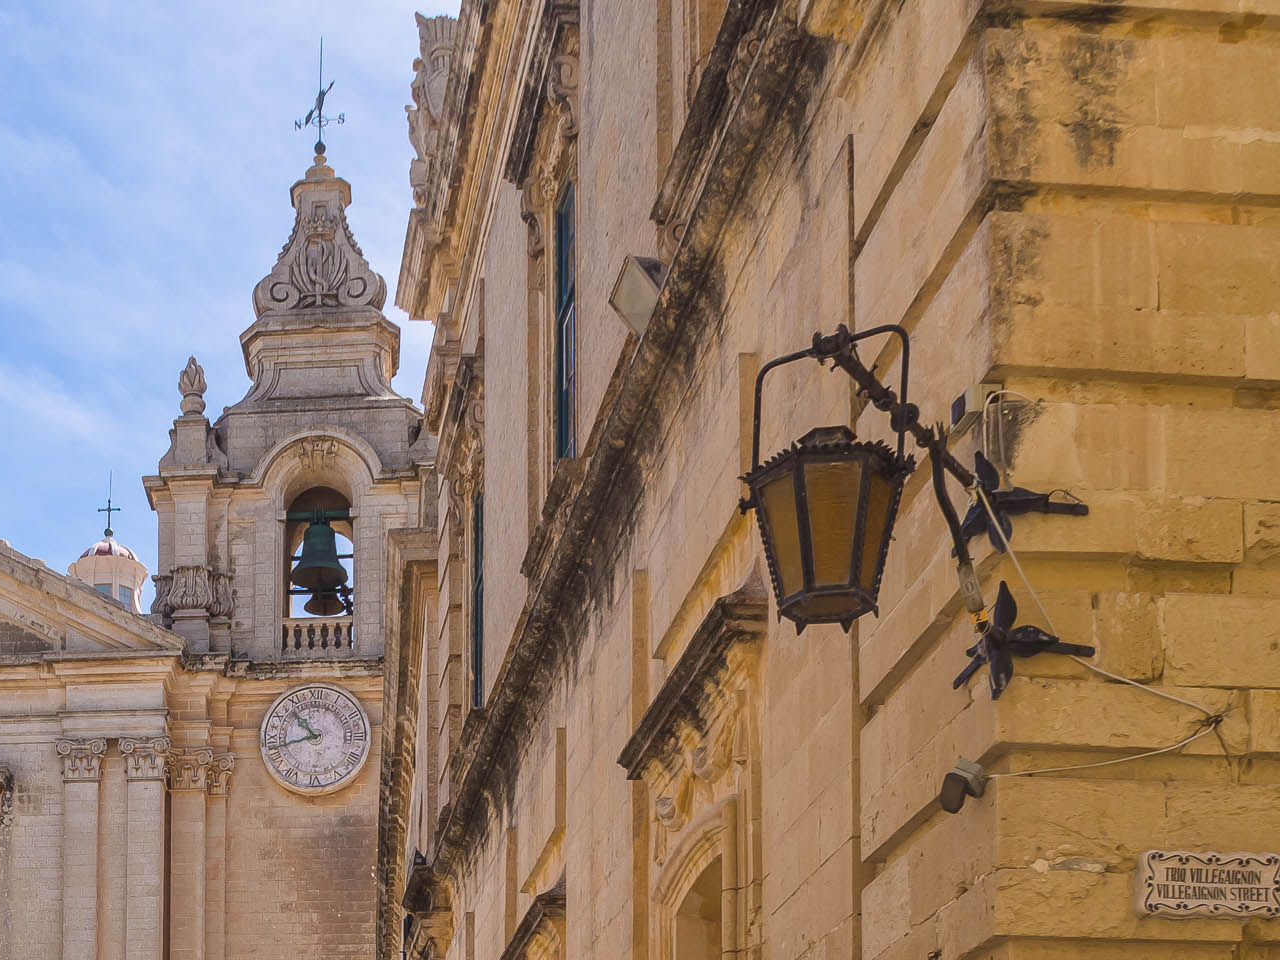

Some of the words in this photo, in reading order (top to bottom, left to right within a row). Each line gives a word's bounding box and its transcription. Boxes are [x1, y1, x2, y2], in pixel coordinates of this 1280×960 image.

[309, 689, 323, 700] XII
[288, 694, 301, 708] XI
[273, 711, 284, 722] X
[348, 710, 359, 720] II
[266, 733, 278, 744] IX
[353, 731, 364, 741] III
[285, 768, 297, 784] VII
[309, 775, 321, 785] VI
[1165, 867, 1186, 882] TRIQ
[1190, 868, 1262, 885] VILLEGAIGNON
[1157, 884, 1227, 900] VILLEGAIGNON
[1230, 887, 1270, 902] STREET
